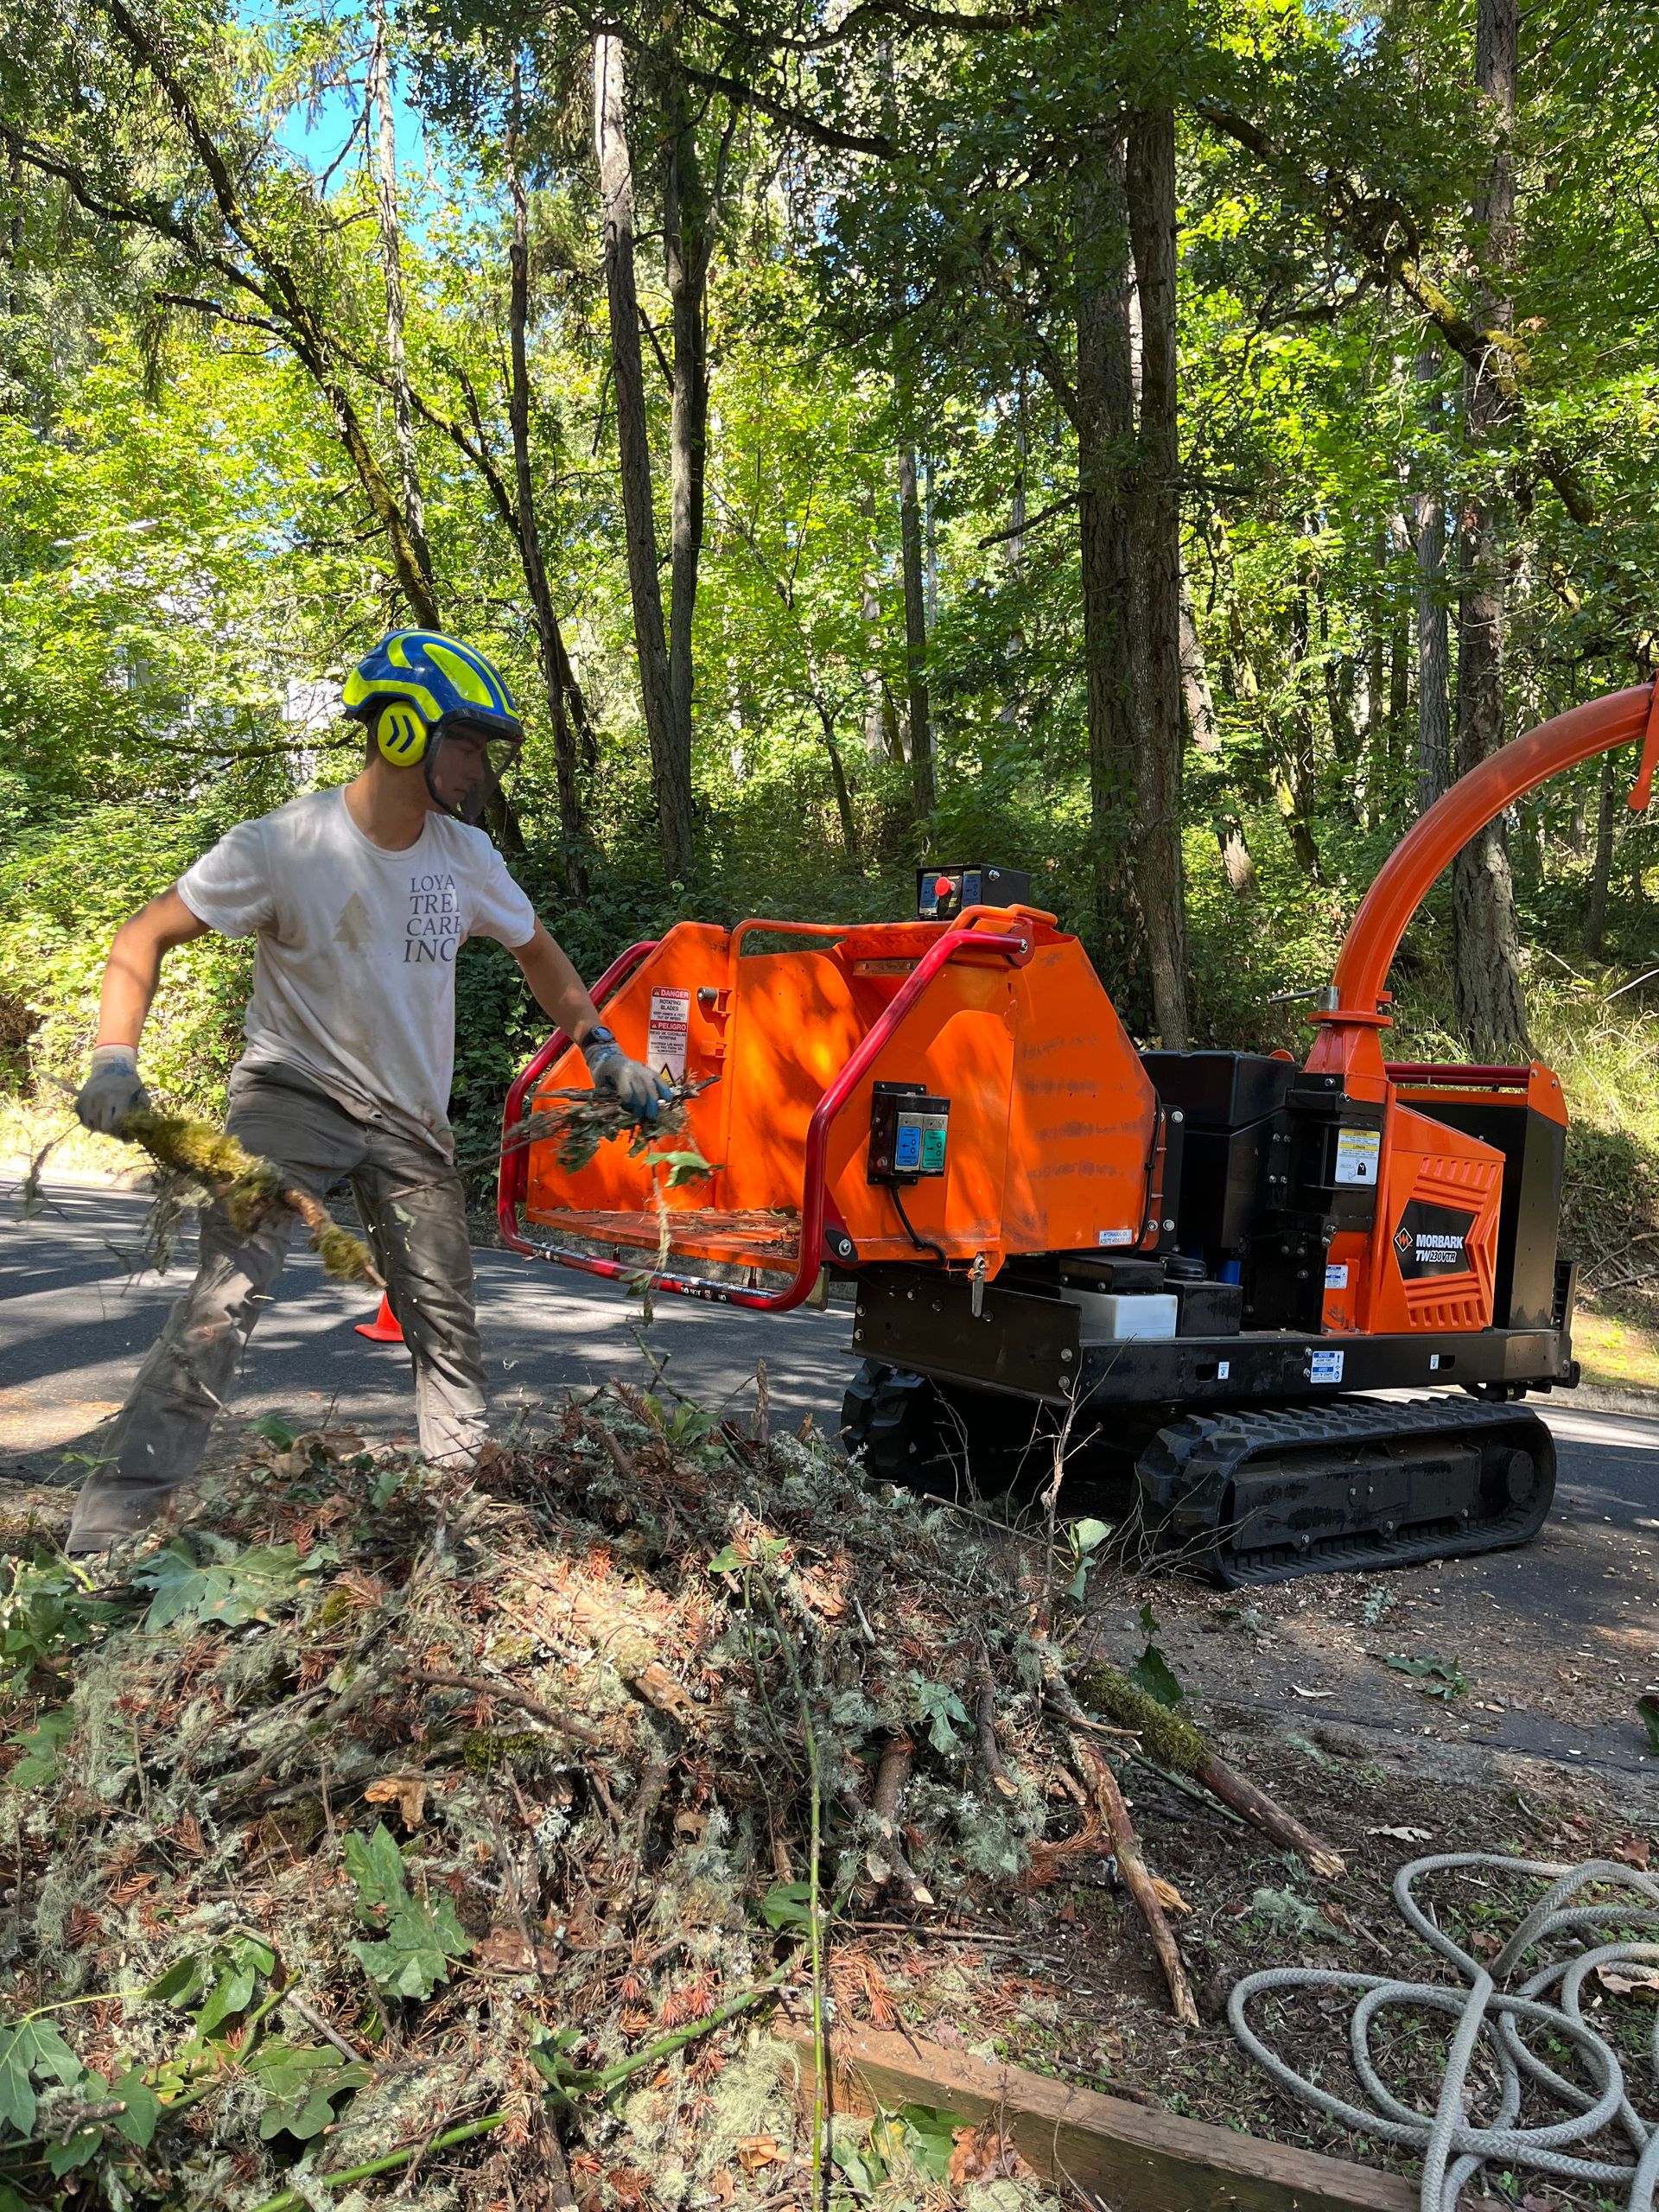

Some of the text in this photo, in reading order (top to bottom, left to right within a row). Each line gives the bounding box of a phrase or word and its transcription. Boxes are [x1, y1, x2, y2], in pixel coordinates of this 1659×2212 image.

[410, 874, 455, 893] LOYA
[661, 989, 689, 999] DANGER
[658, 1020, 687, 1031] PELIGRO
[1415, 1234, 1464, 1249] MORBARK
[1415, 1249, 1457, 1263] TW230VTR
